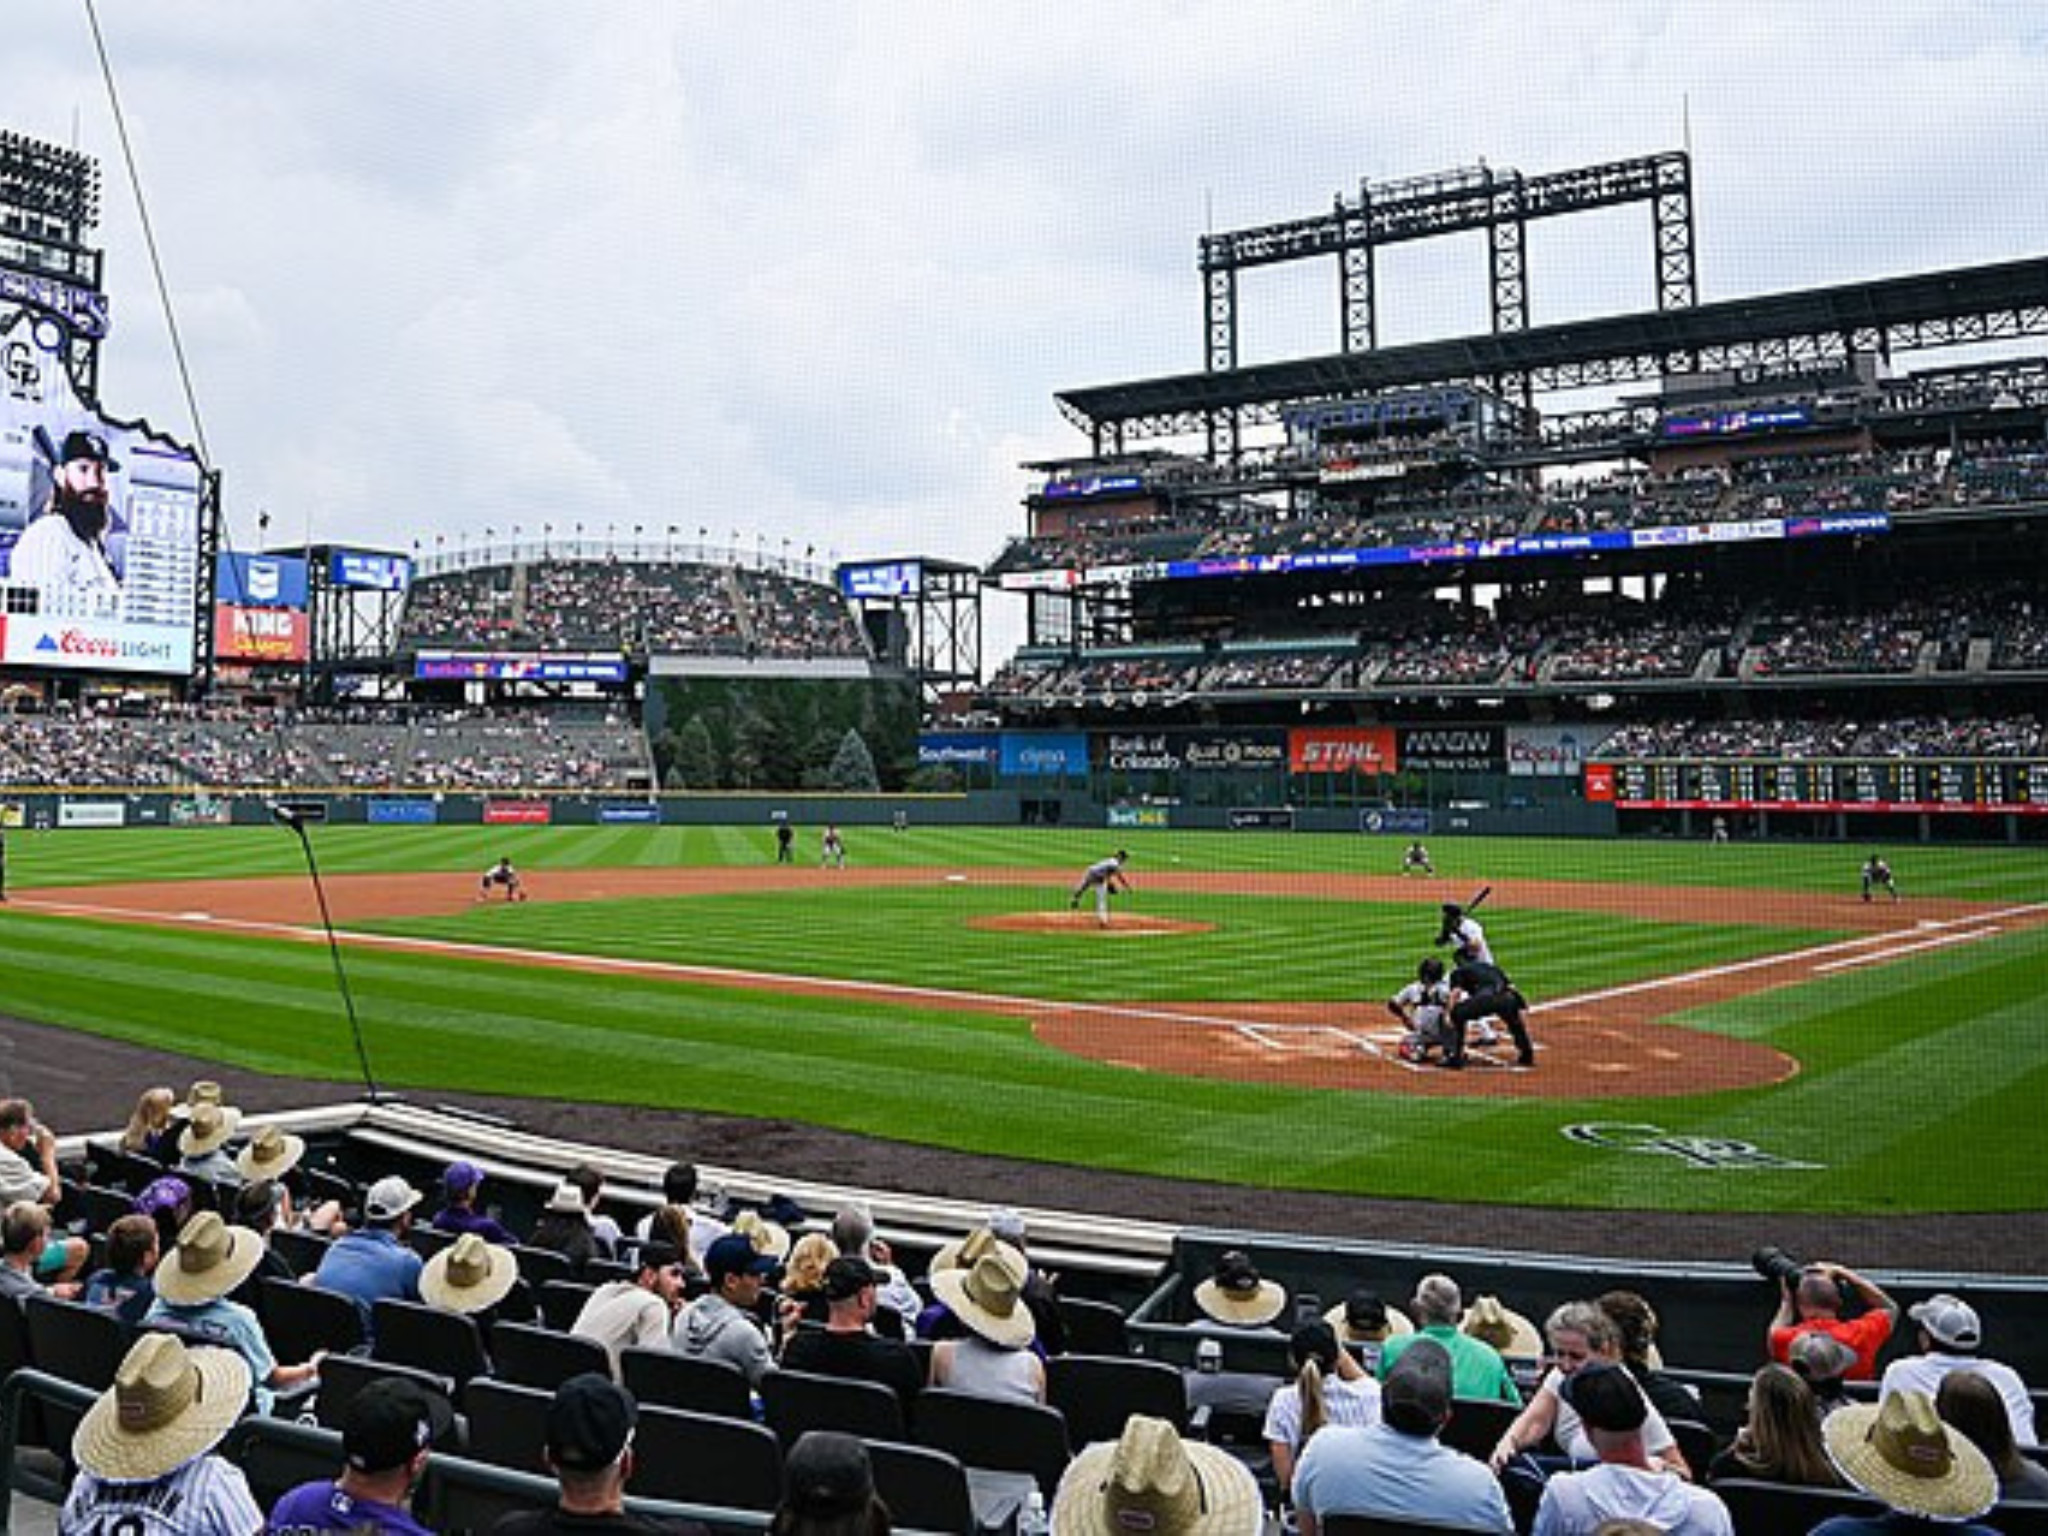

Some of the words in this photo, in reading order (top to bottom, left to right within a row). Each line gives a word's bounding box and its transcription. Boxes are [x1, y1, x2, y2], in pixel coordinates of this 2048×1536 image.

[234, 608, 293, 636] KING
[61, 627, 118, 656] Coors
[121, 641, 172, 659] LIGHT
[1110, 734, 1146, 751] Bank
[1150, 734, 1167, 751] of
[1186, 742, 1220, 761] BLUE
[1244, 744, 1282, 758] MOON
[1406, 732, 1491, 752] ARROW
[918, 746, 990, 762] Southwest
[1110, 753, 1182, 770] Colorado
[1302, 741, 1382, 763] STIHL
